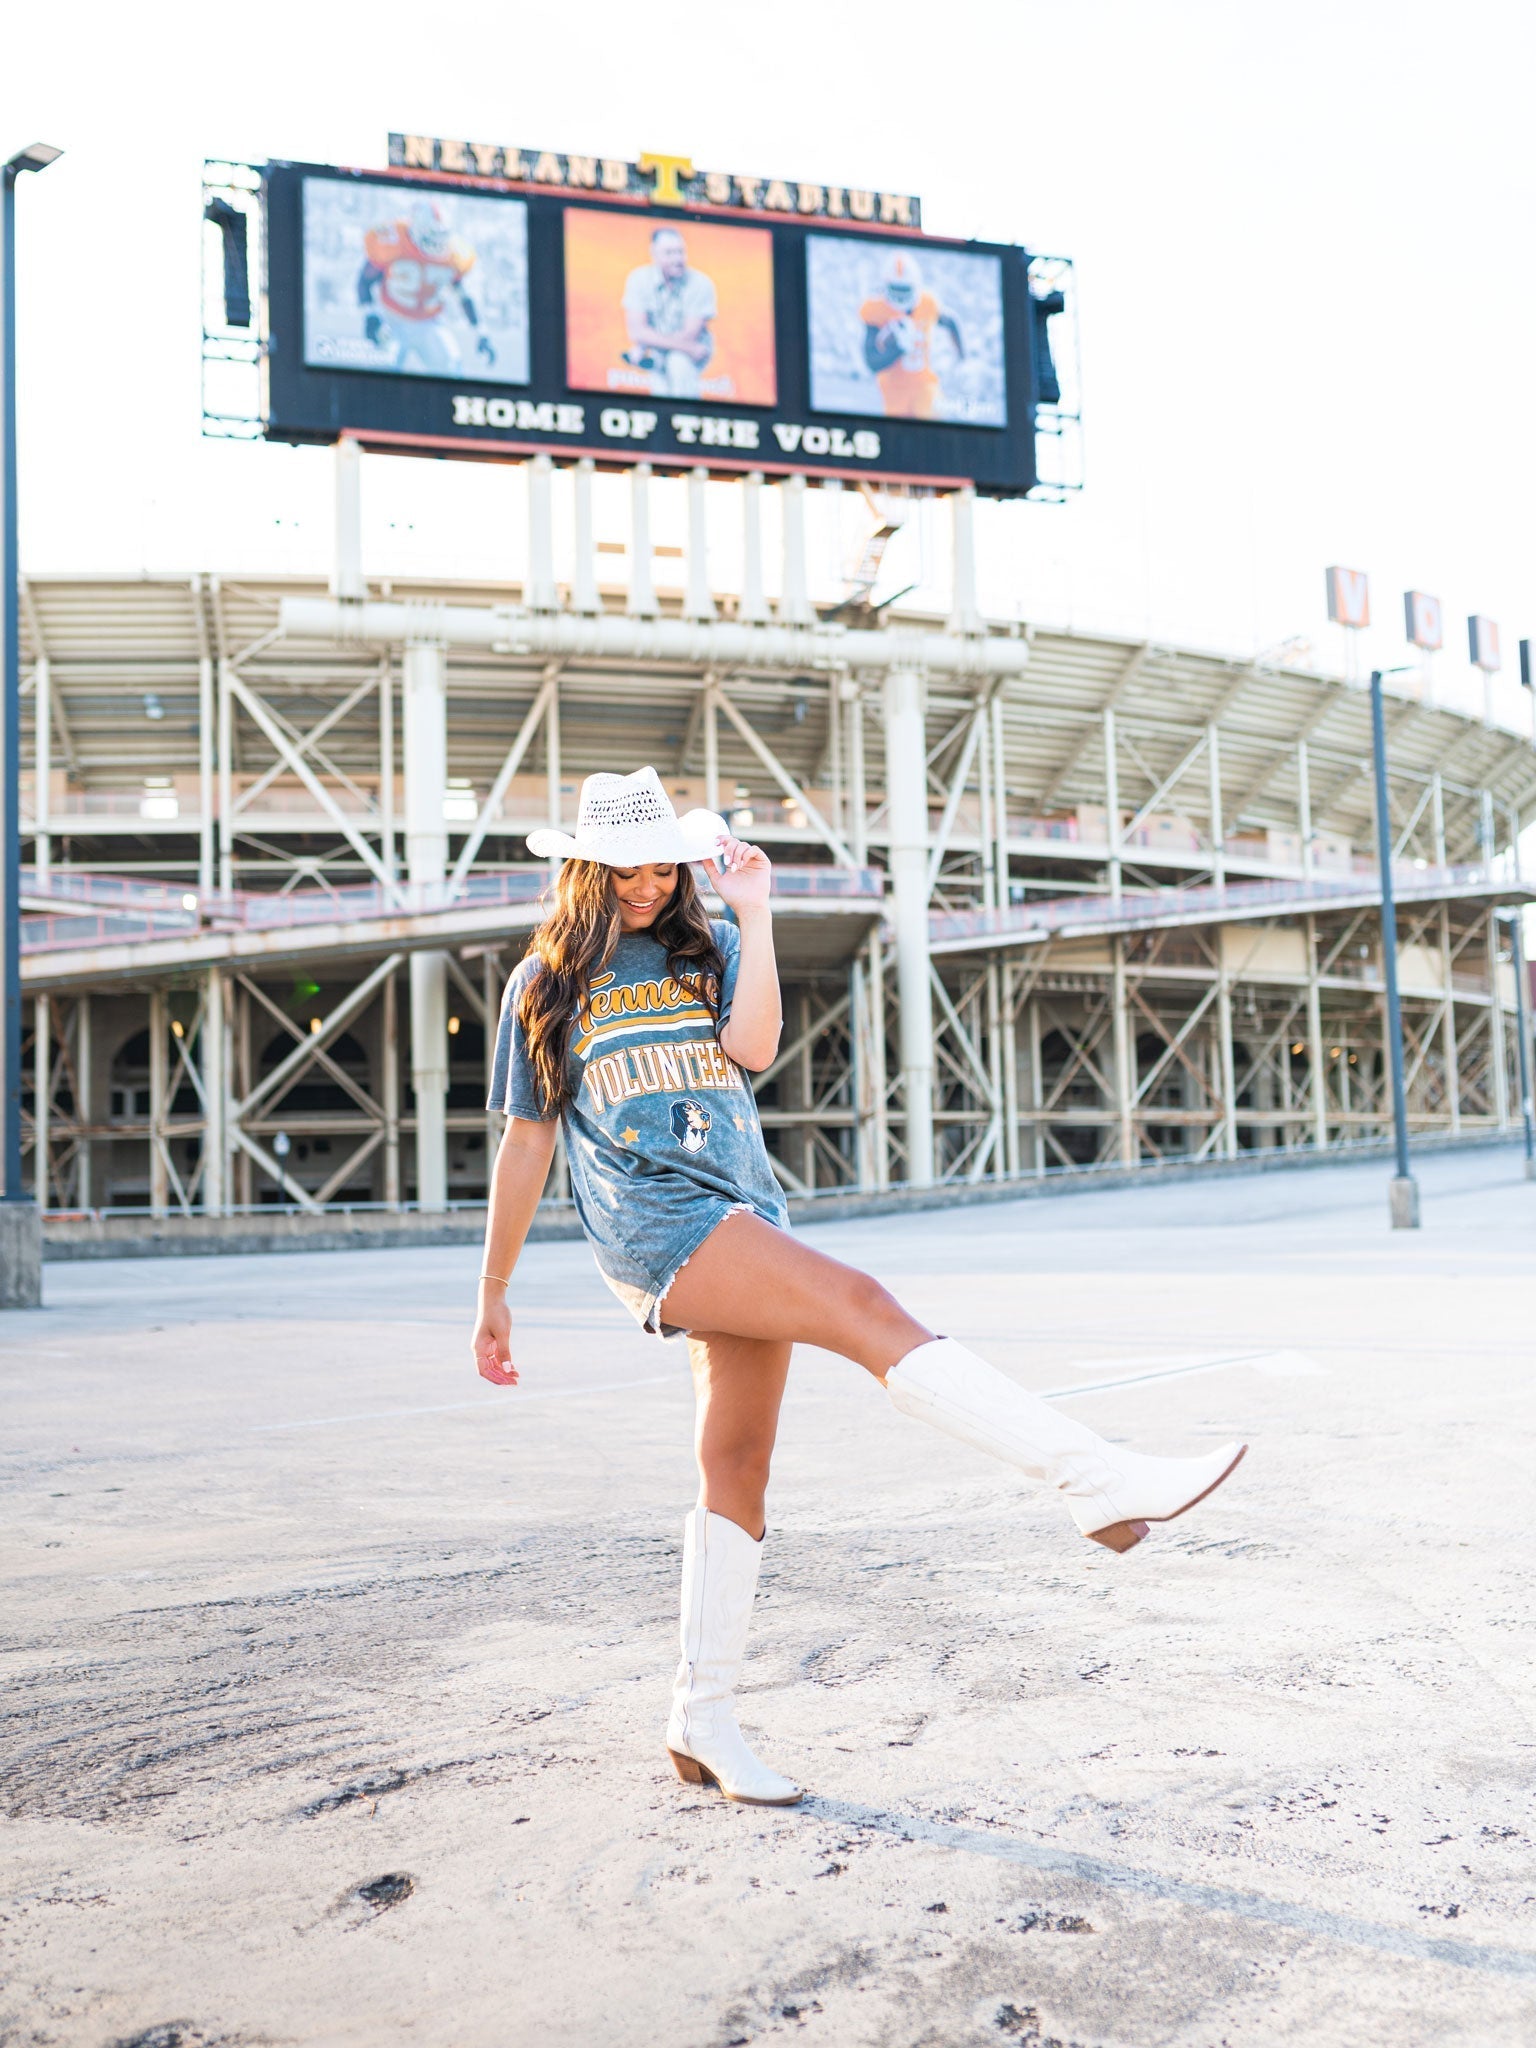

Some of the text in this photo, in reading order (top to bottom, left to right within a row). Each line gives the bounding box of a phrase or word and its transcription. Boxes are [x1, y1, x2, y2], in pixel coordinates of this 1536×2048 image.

[402, 134, 912, 225] NEYLAND T STADIUM
[452, 395, 881, 460] HOME OF THE VOLS
